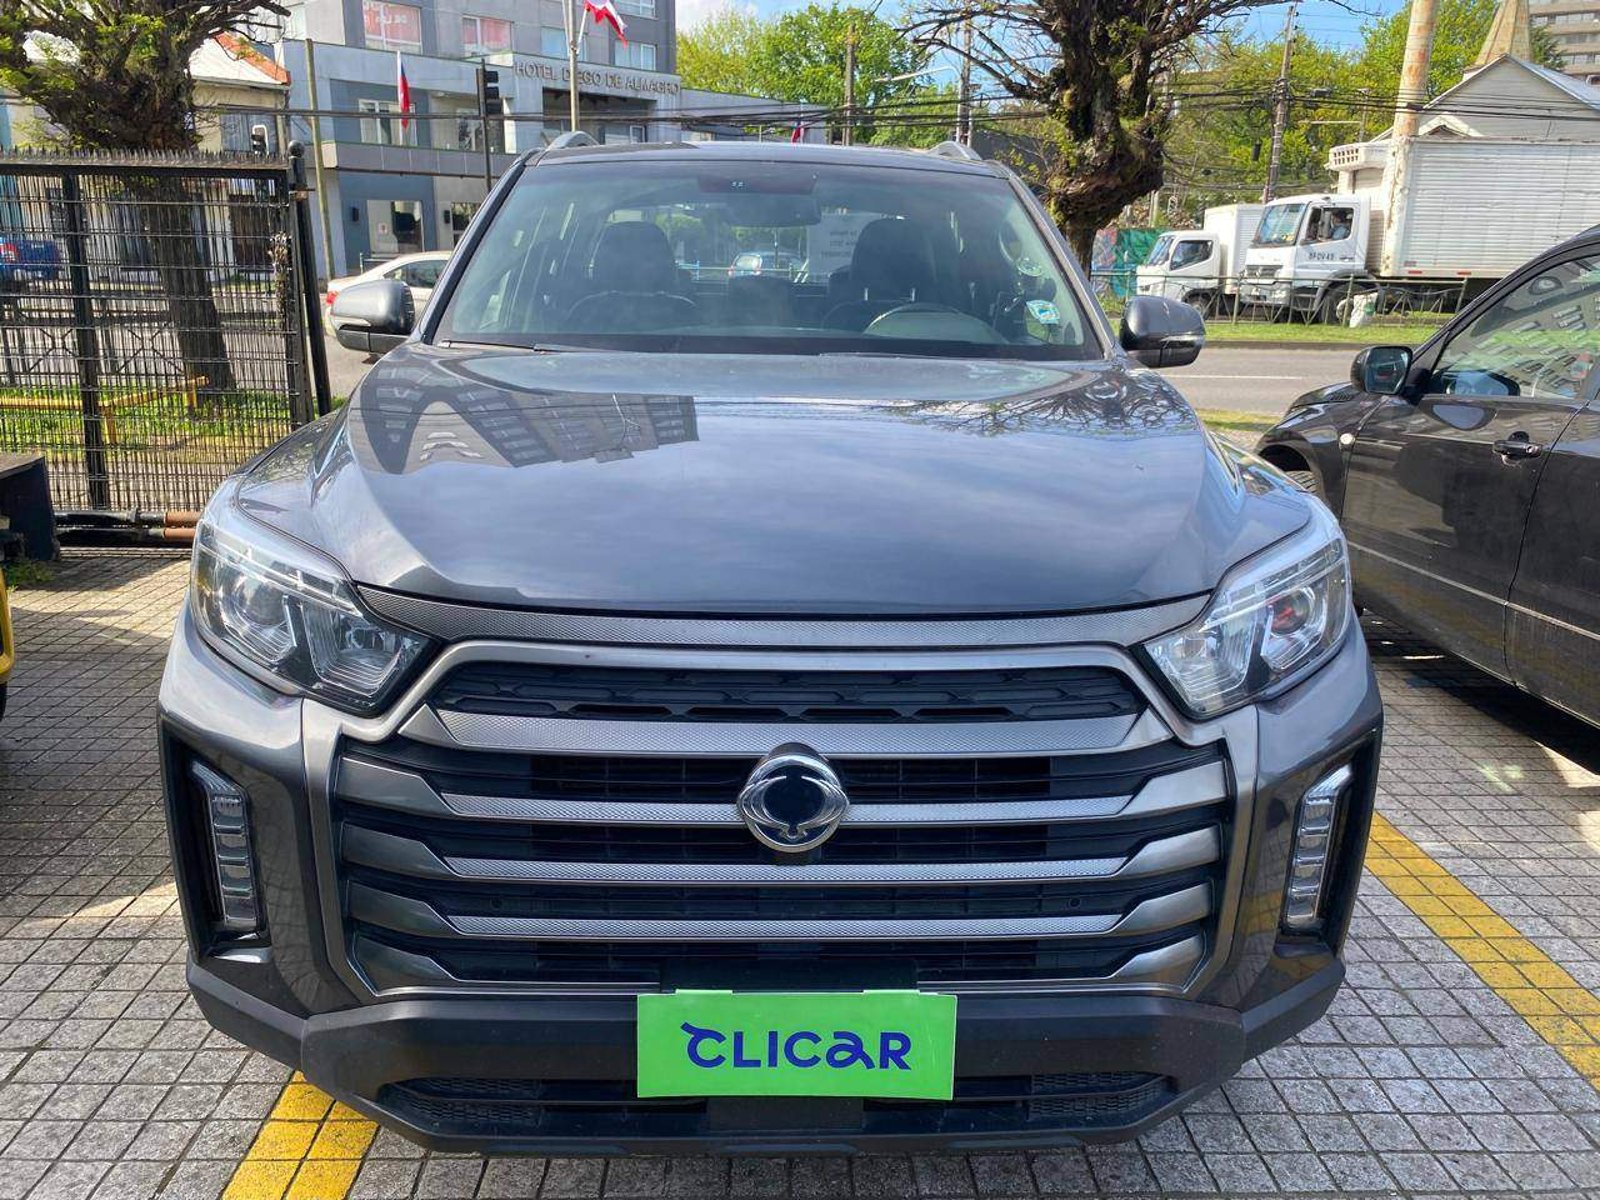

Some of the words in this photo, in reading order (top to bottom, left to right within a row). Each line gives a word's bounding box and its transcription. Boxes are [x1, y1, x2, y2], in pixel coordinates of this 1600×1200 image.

[514, 60, 557, 81] HOTEL
[561, 67, 602, 87] DEGO
[605, 72, 624, 90] DE
[625, 75, 680, 96] ALMAGRO
